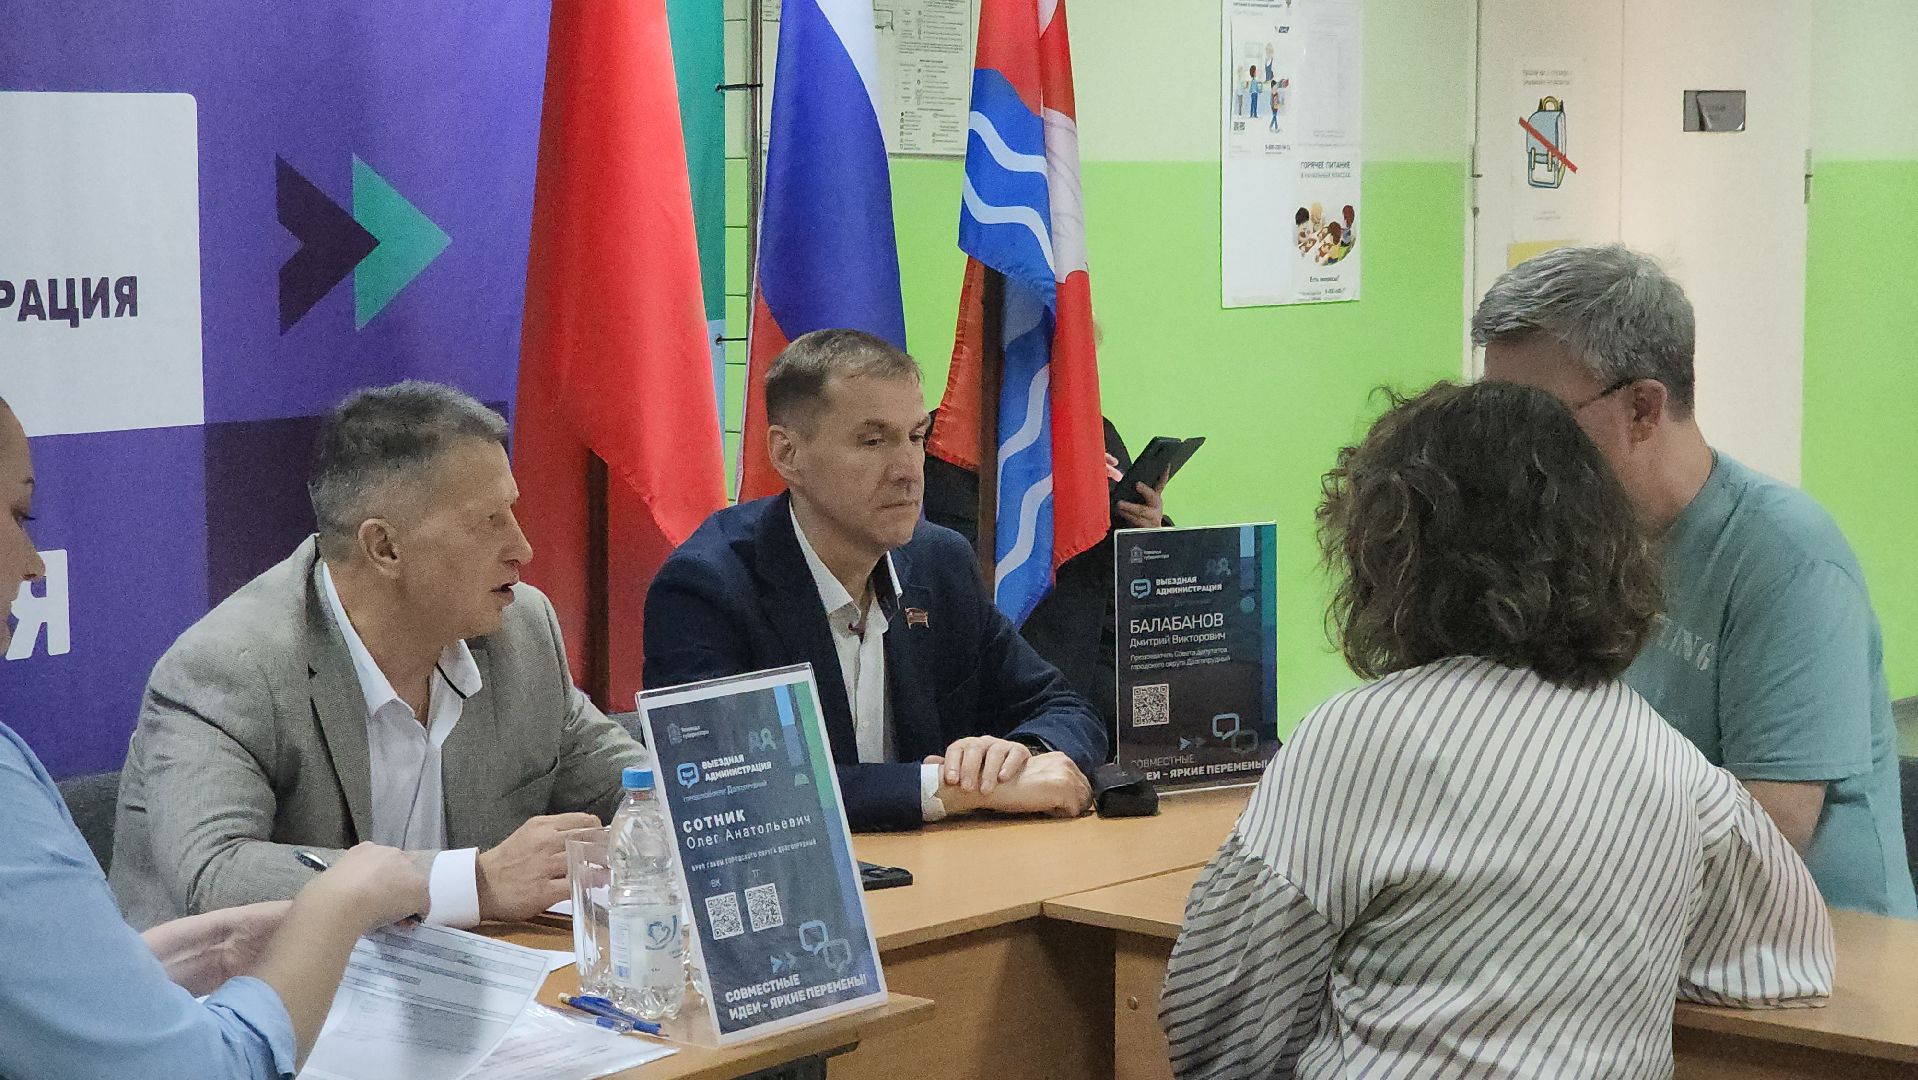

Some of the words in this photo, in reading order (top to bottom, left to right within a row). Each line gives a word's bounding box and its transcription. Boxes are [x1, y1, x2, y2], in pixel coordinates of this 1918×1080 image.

[0, 276, 138, 328] РАЦИЯ
[1156, 576, 1197, 586] ВЫЕЗДНАЯ
[1156, 583, 1222, 596] АДМИНИСТРАЦИЯ
[1130, 612, 1224, 634] БАЛАБАНОВ
[1129, 635, 1170, 648] Дмитрий
[1172, 632, 1226, 645] Викторович
[702, 754, 744, 770] ВЫЕЗДНАЯ
[704, 761, 772, 782] АДМИНИСТРАЦИЯ
[1170, 766, 1205, 778] ЯРКИЕ
[682, 809, 746, 834] СОТНИК
[686, 834, 719, 849] Олег
[725, 814, 812, 842] Анатольевич
[711, 879, 722, 888] ВК
[725, 974, 800, 1003] СОВМЕСТНЫЕ
[728, 1001, 762, 1021] ИДЕИ
[769, 989, 806, 1010] ЯРКИЕ
[806, 974, 867, 999] ПЕРЕМЕНЫ!
